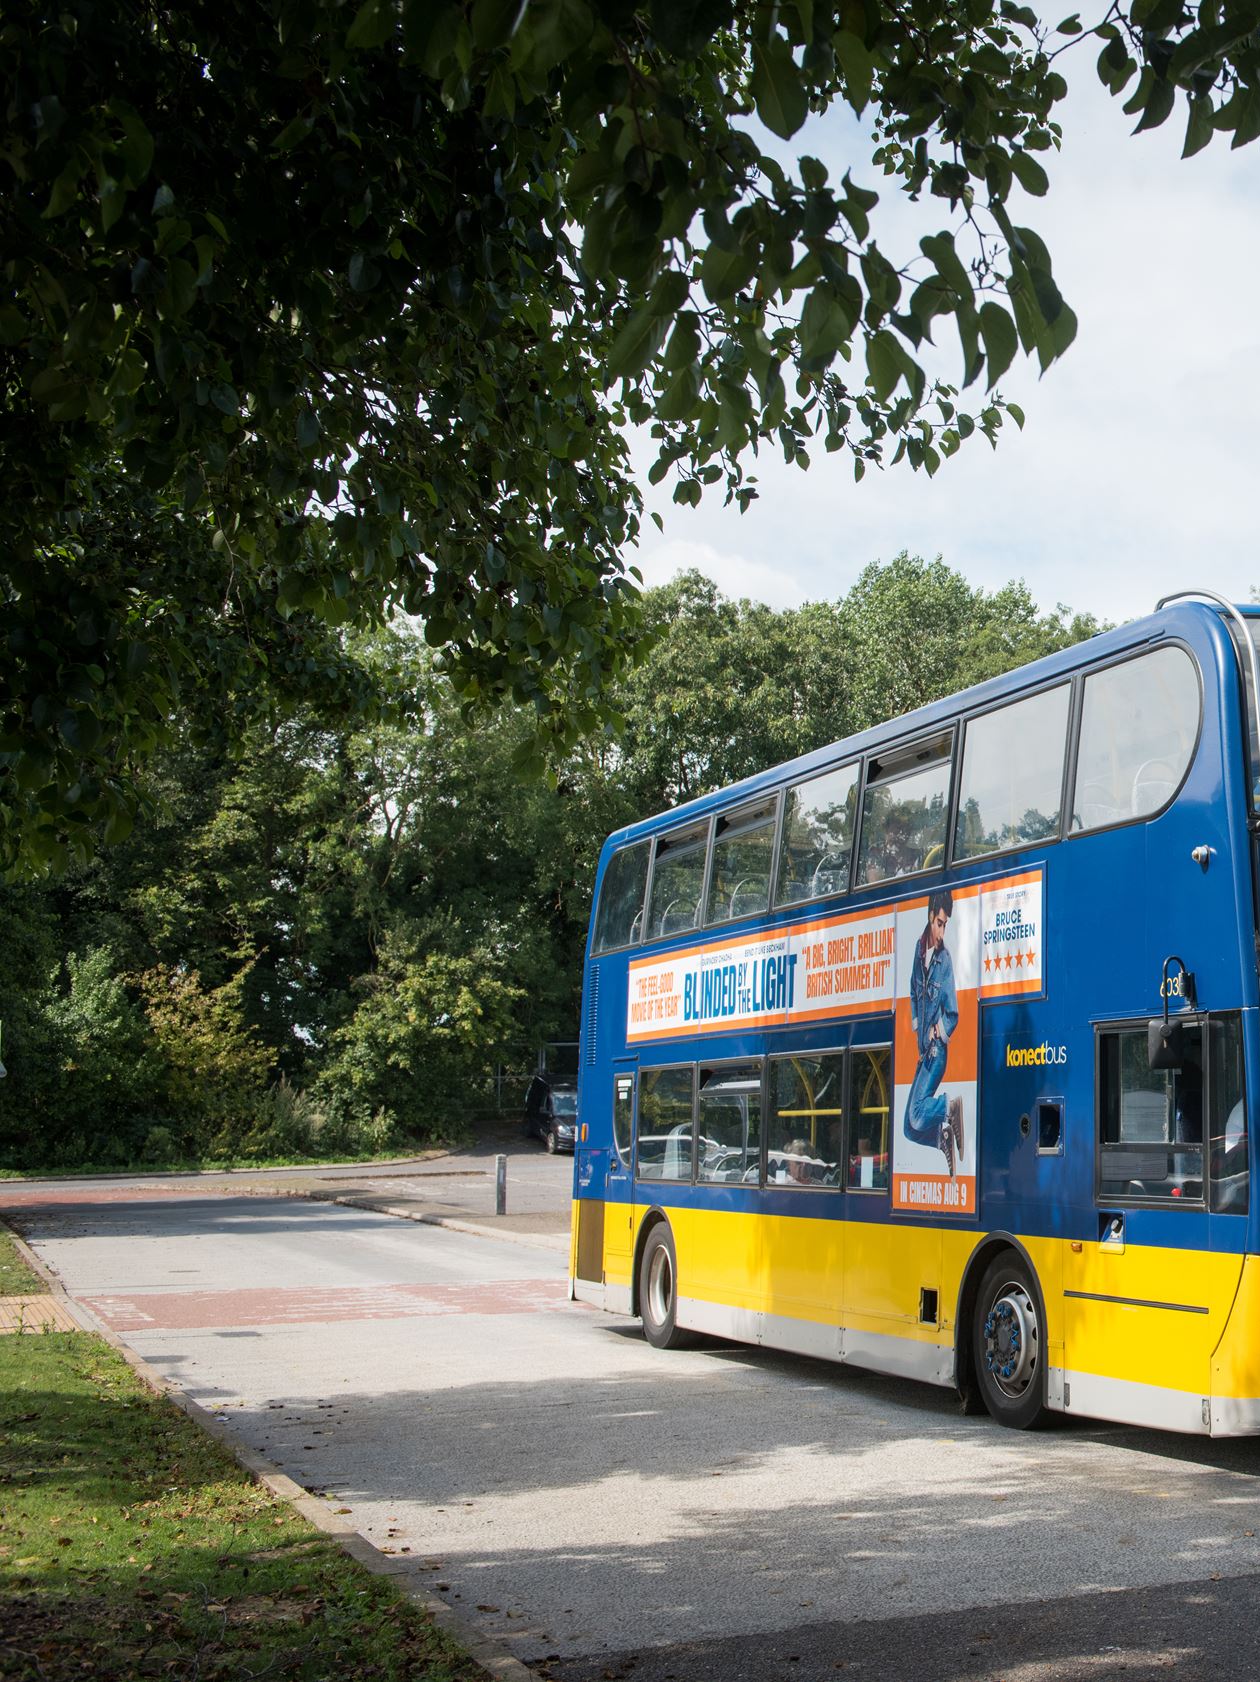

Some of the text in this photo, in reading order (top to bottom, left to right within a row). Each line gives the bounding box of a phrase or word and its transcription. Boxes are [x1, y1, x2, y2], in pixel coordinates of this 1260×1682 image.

[996, 909, 1021, 927] BRUCE
[984, 922, 1035, 945] SPRINGSTEEN
[812, 943, 826, 969] BIG,
[827, 936, 856, 966] BRIGHT,
[858, 927, 895, 960] BRILLIANT
[647, 971, 674, 996] FEEL-GOOD
[738, 962, 748, 987] BY
[752, 954, 797, 1012] LIGHT
[806, 970, 833, 999] BRITISH
[834, 963, 871, 994] SUMMER
[684, 965, 737, 1021] BLINDED
[738, 988, 751, 1014] THE
[631, 999, 647, 1023] MOVIE
[647, 999, 654, 1021] OF
[654, 997, 664, 1020] THE
[1006, 1040, 1067, 1067] konectbus
[900, 1181, 967, 1207] IN CINEMAS AUG 9
